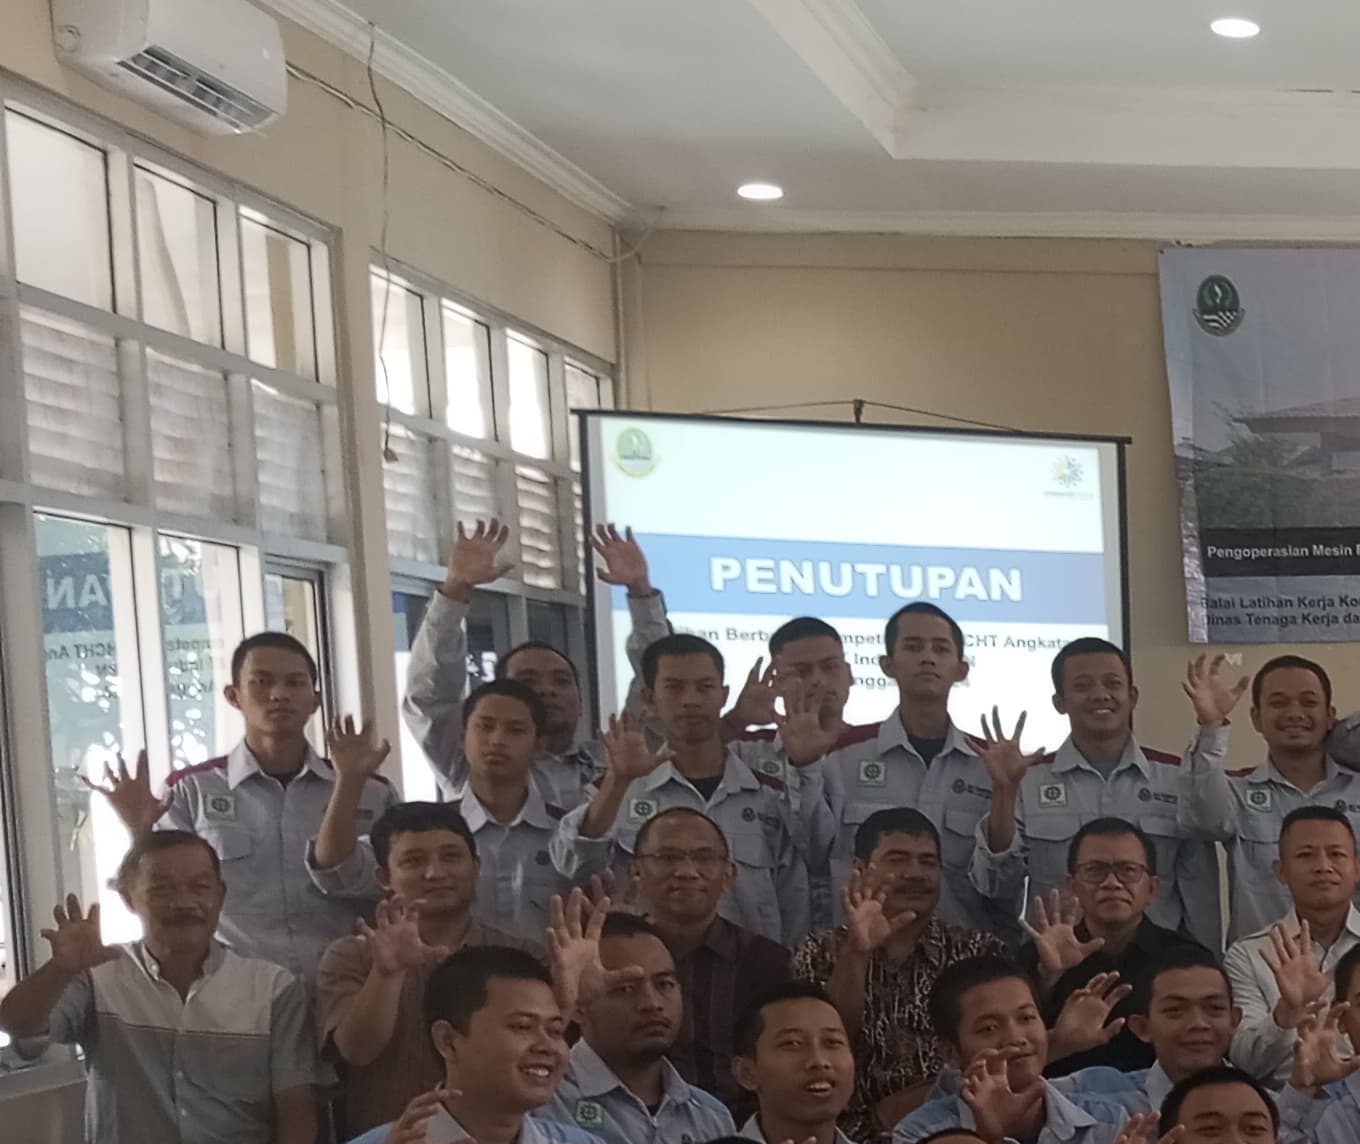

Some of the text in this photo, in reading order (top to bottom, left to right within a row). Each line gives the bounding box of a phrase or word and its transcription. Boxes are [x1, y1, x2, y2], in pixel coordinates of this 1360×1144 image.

[1207, 545, 1309, 560] Pengoperasian
[1312, 544, 1353, 557] Mesin
[710, 556, 1024, 603] PENUTUPAN
[1240, 596, 1294, 609] Latihan
[1297, 595, 1335, 611] Kerja
[1206, 613, 1241, 626] inas
[1247, 612, 1297, 628] Tenaga
[1301, 612, 1339, 628] Kerja
